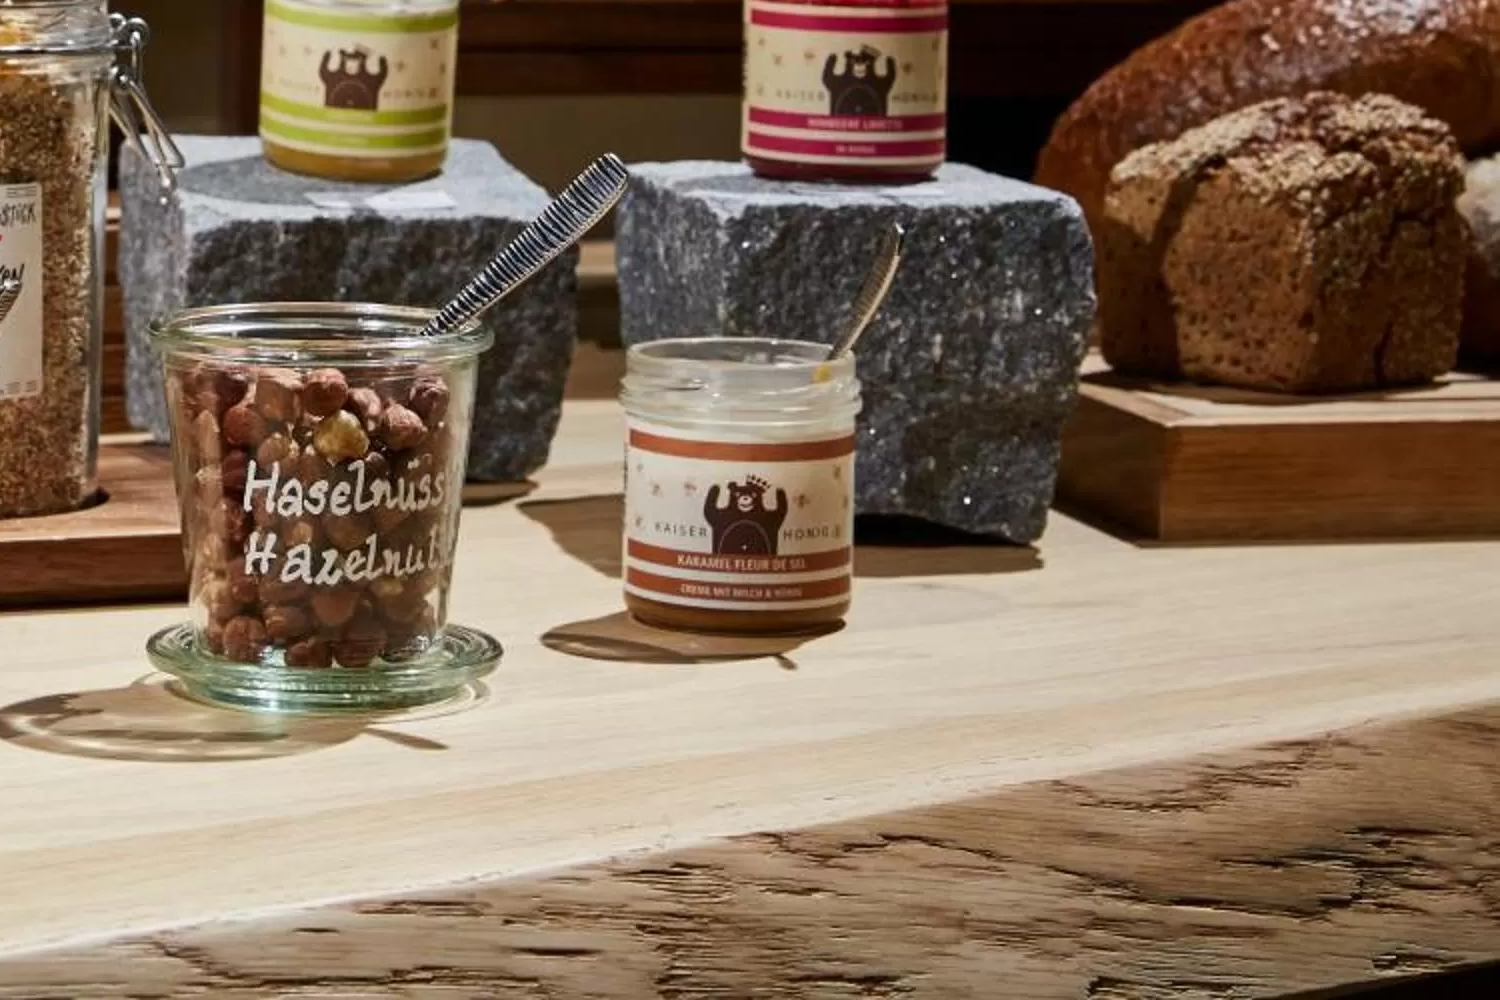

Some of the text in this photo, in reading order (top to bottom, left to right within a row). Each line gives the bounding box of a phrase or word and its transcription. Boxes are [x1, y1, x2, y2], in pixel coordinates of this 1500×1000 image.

[243, 459, 446, 517] Haselnüss
[655, 522, 829, 541] KAISER HONIG
[243, 528, 446, 585] Hazelnut
[677, 553, 807, 571] KARAMEL FLEUR DE SEL
